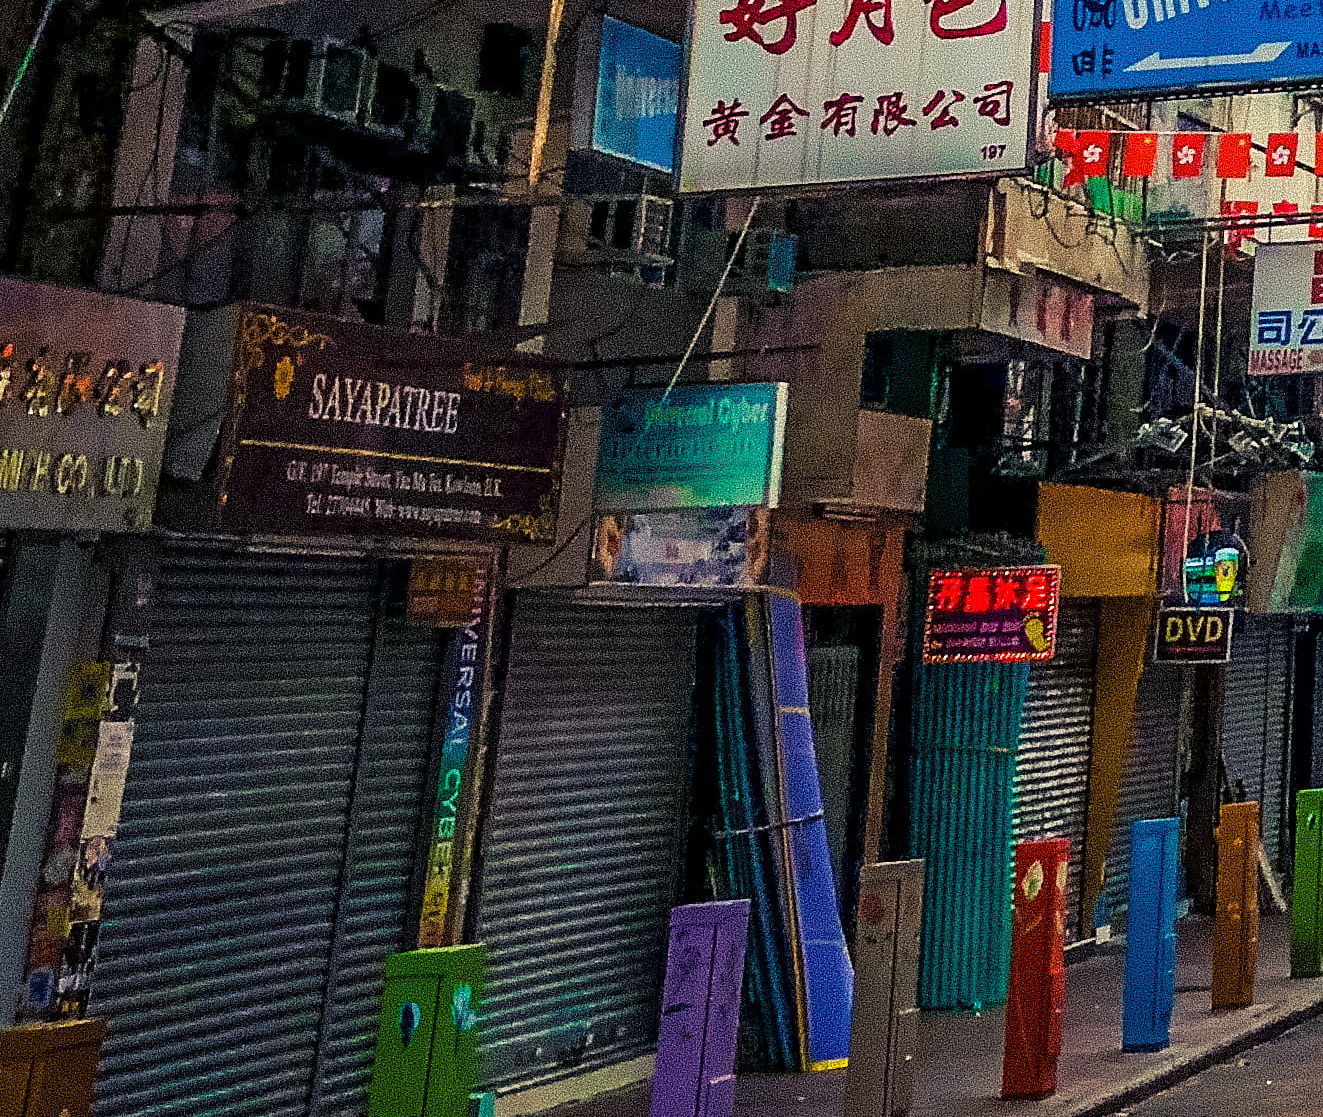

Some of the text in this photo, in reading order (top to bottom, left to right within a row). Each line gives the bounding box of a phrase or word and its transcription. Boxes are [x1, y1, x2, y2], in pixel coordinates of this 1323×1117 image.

[1250, 348, 1303, 373] MASSAGE
[308, 372, 461, 434] SAYAPATREE
[1165, 616, 1223, 643] DVD
